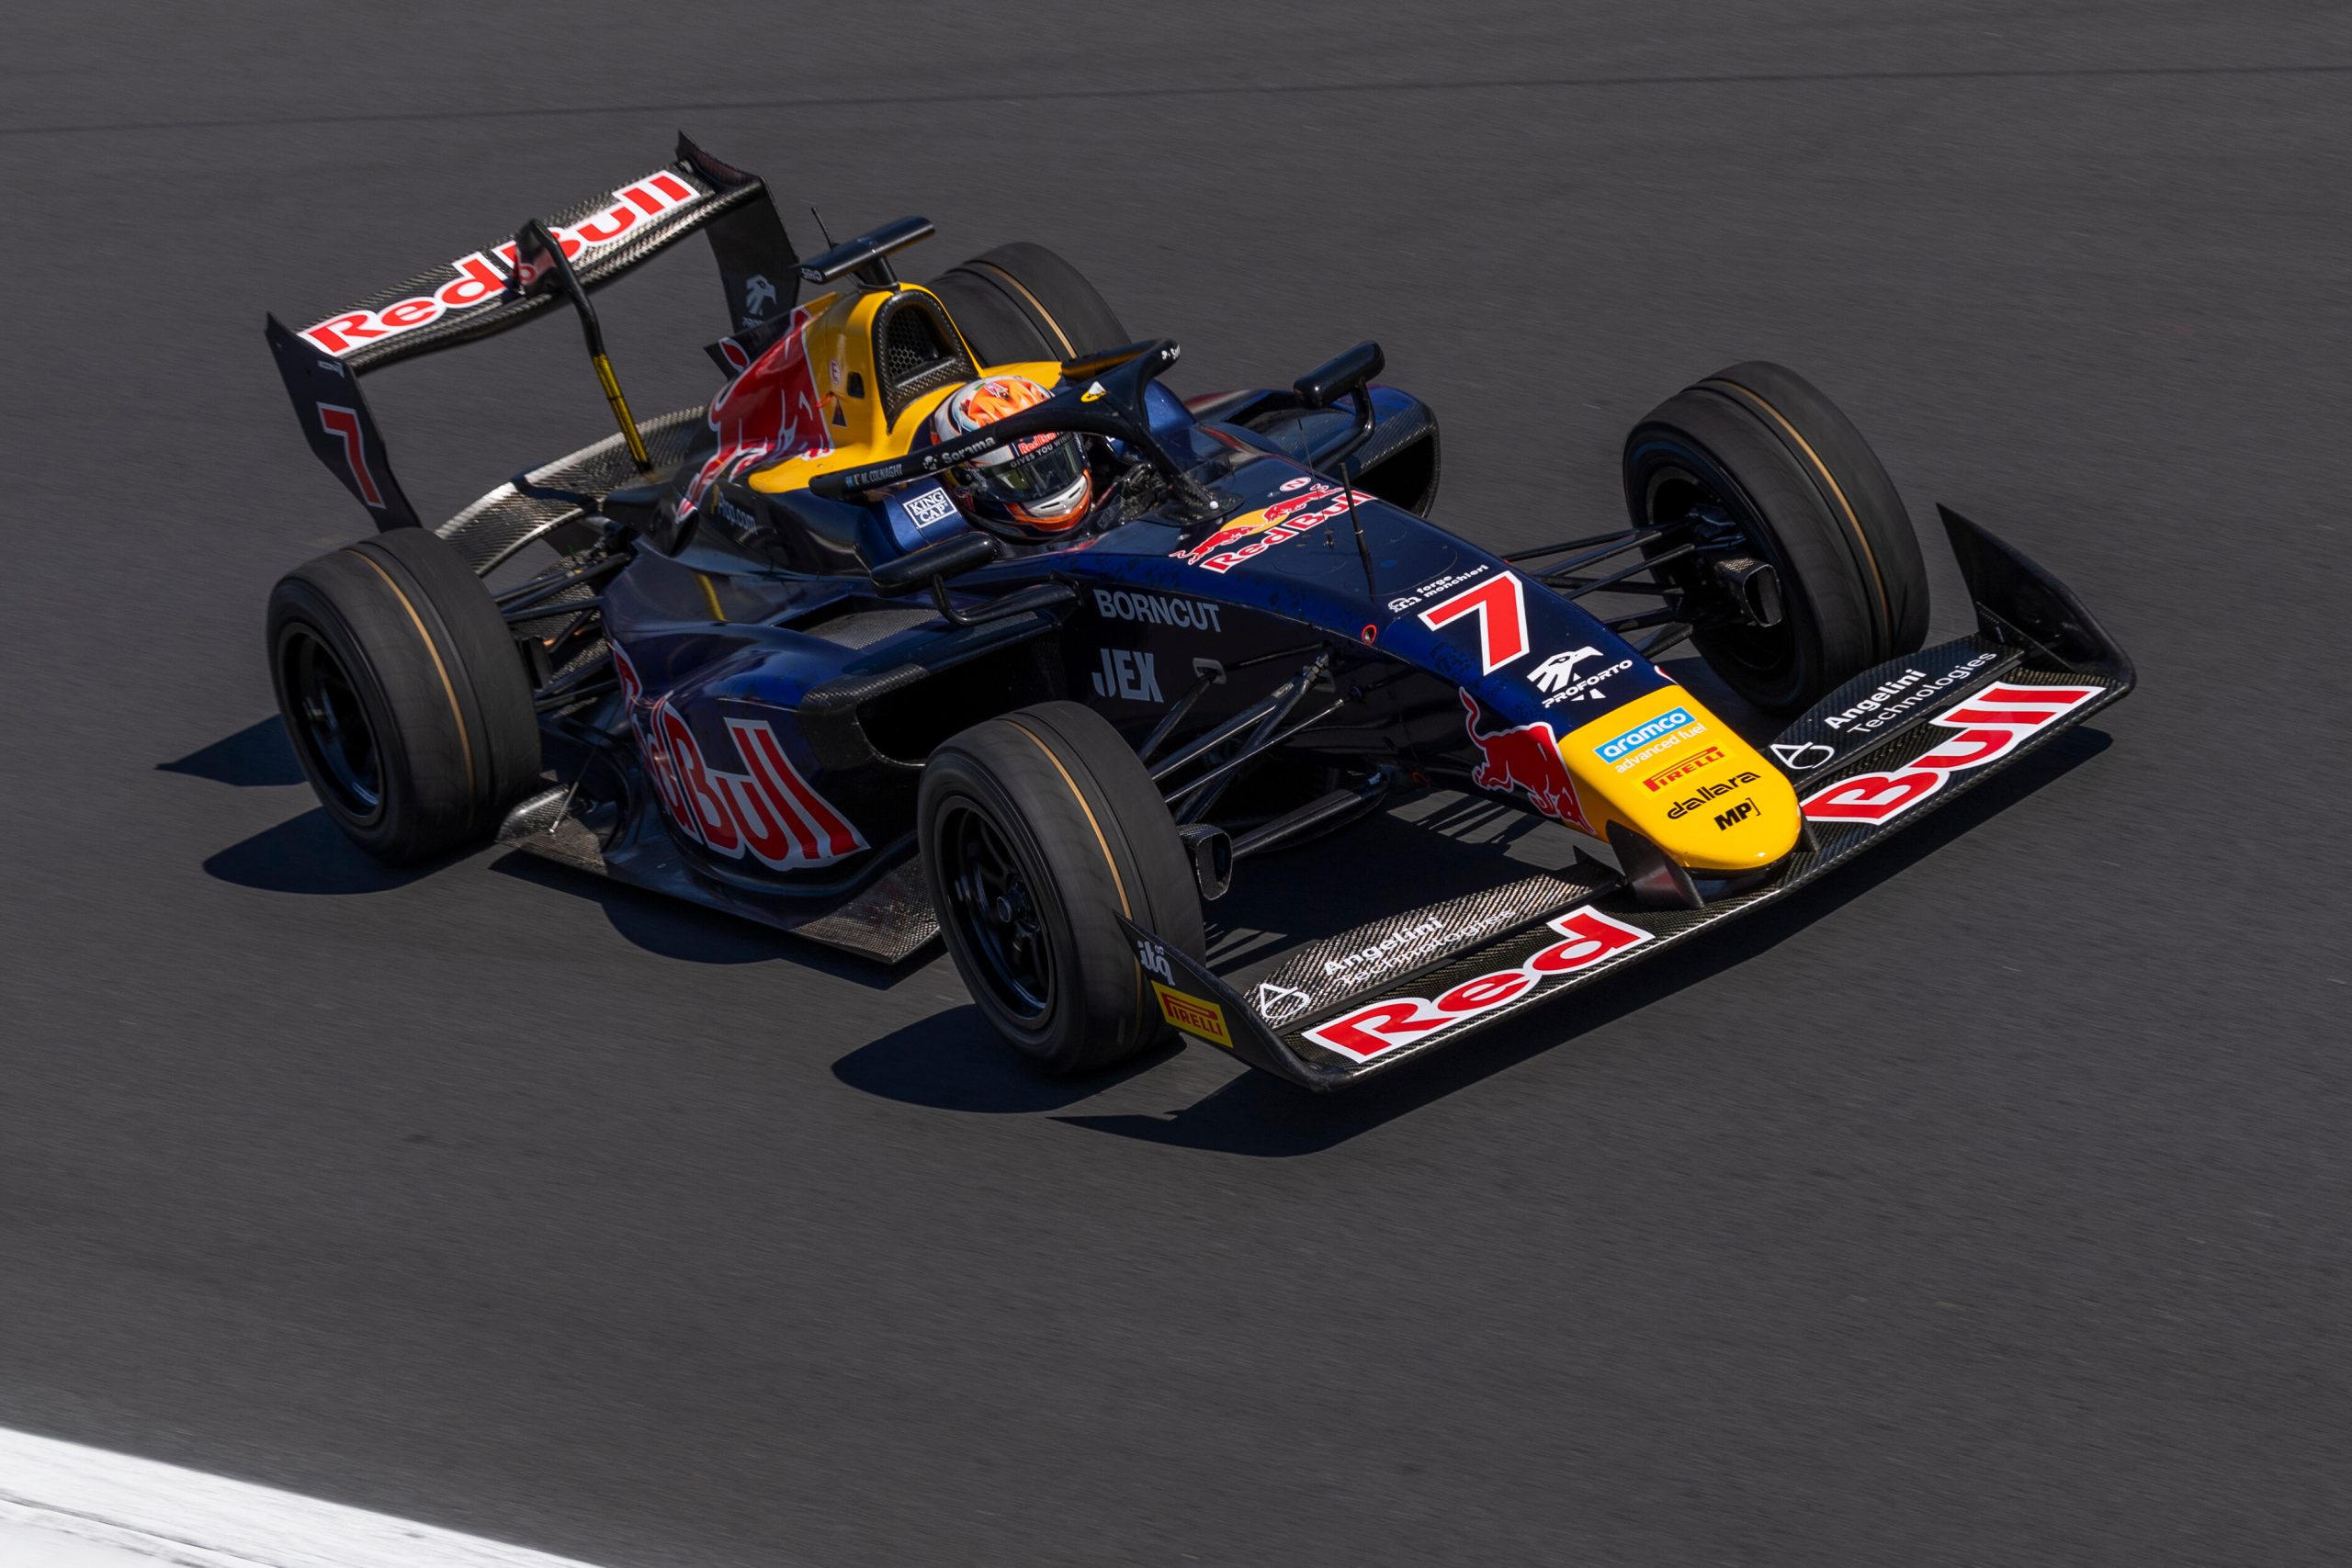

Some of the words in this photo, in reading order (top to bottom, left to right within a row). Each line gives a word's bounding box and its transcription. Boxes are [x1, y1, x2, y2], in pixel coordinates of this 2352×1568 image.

[303, 254, 508, 355] Red
[316, 401, 387, 508] 7
[942, 436, 997, 465] Sorama
[1010, 453, 1035, 468] GIVES
[1035, 445, 1053, 457] YOU
[909, 491, 945, 514] KING
[1202, 527, 1296, 572] Red
[1283, 491, 1375, 530] Bull
[1416, 575, 1453, 594] forge
[1423, 564, 1490, 599] monchieri
[1093, 589, 1223, 633] BORNCUT
[1421, 573, 1529, 674] 7
[1091, 648, 1164, 704] JEX
[1542, 660, 1634, 709] PROFORTO
[1826, 668, 1928, 729] Angelini
[1848, 650, 1997, 734] Technologies
[1603, 712, 1688, 758] aramco
[1615, 735, 1680, 773] advanced
[1678, 723, 1708, 741] fuel
[1804, 684, 2104, 822] Bull
[663, 704, 869, 869] Bull
[1643, 746, 1725, 793] PIRELLI
[1667, 772, 1761, 820] dallara
[1323, 916, 1444, 976] Angelini
[1337, 909, 1517, 986] Technologies
[1311, 908, 1646, 1059] Red
[1159, 991, 1224, 1037] PIRELLI
